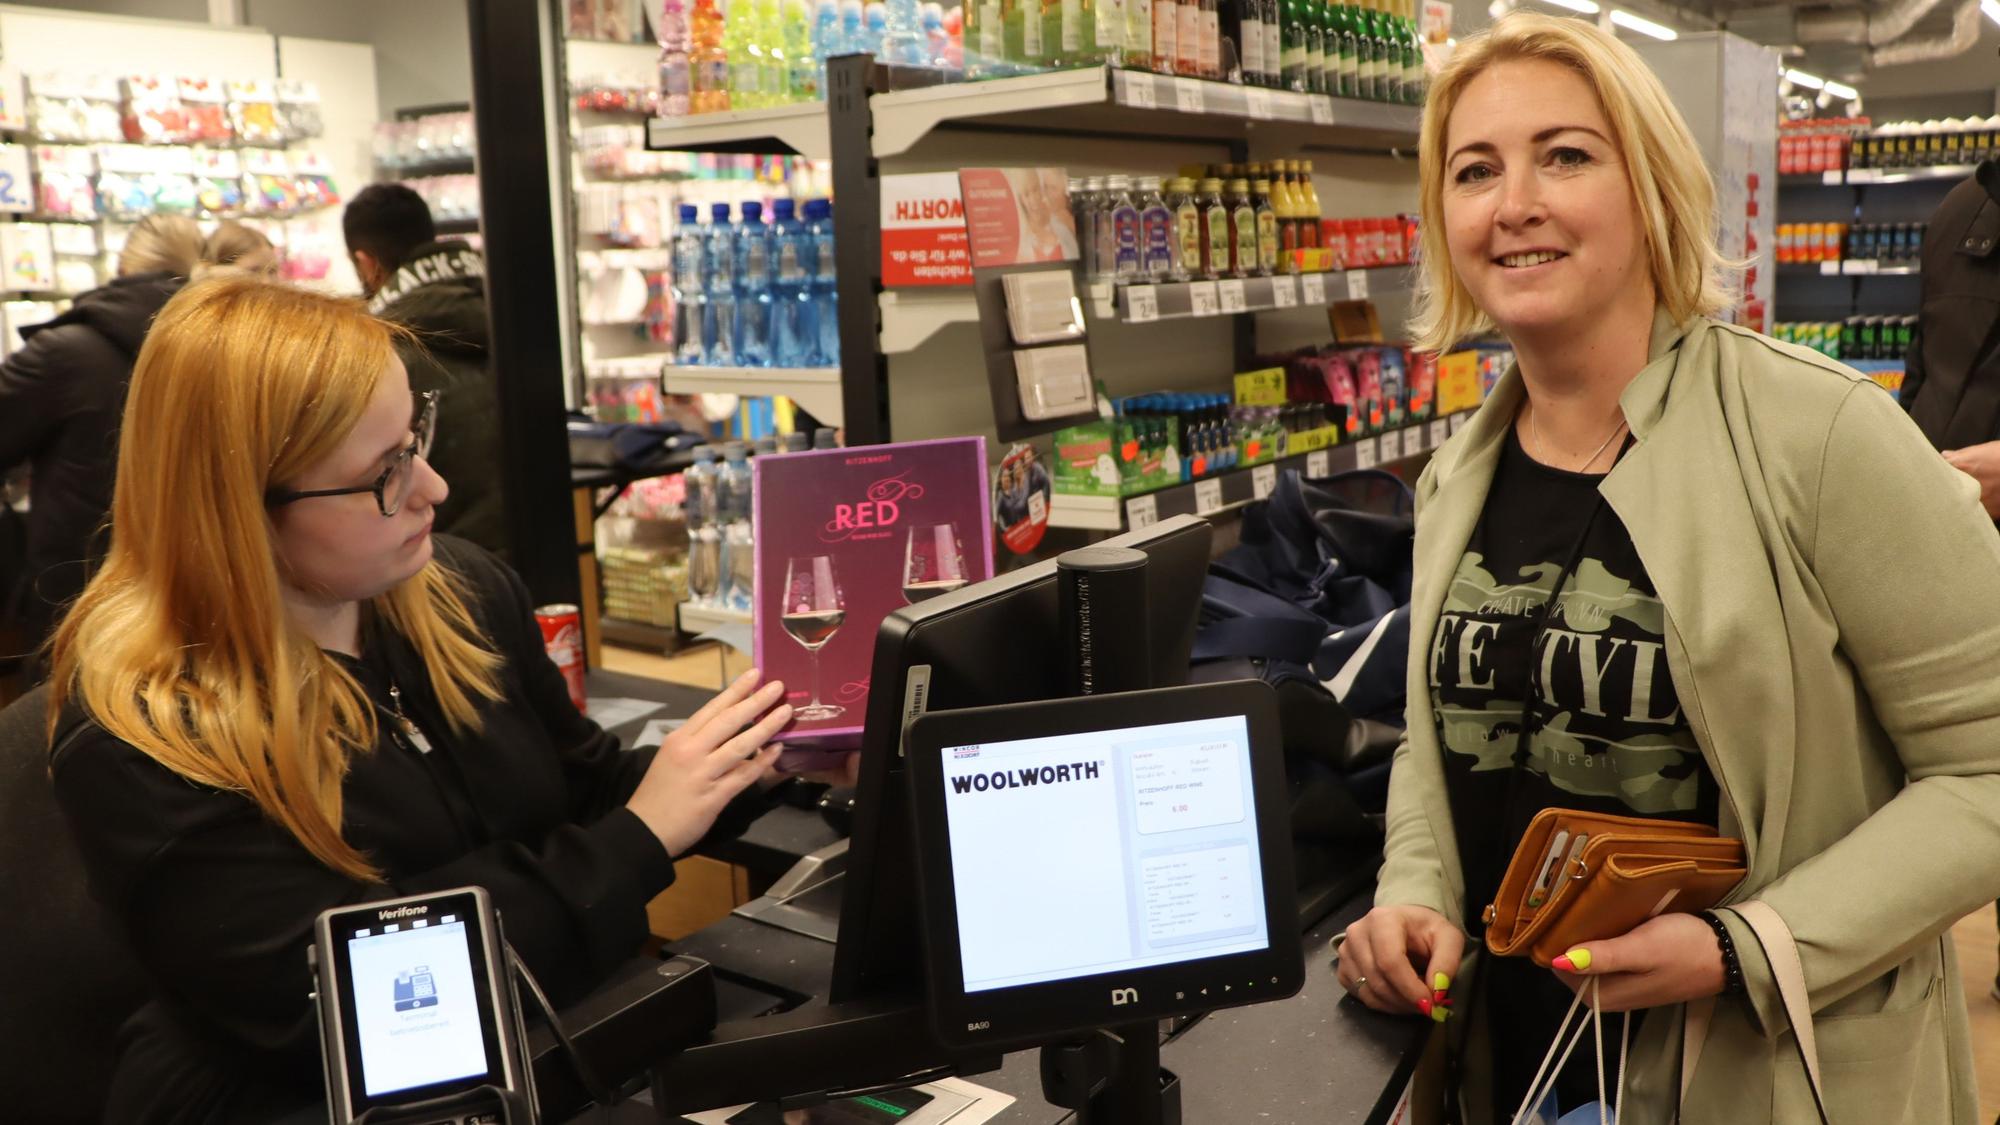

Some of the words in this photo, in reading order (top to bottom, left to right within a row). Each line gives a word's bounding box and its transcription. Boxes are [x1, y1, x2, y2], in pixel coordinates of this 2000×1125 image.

[909, 249, 928, 263] Sie
[929, 249, 946, 262] für
[947, 250, 966, 261] wir
[913, 266, 966, 279] nächsten
[835, 500, 899, 530] RED
[1476, 595, 1535, 619] CREATE
[377, 904, 428, 921] Verifone
[967, 1019, 991, 1031] BA90
